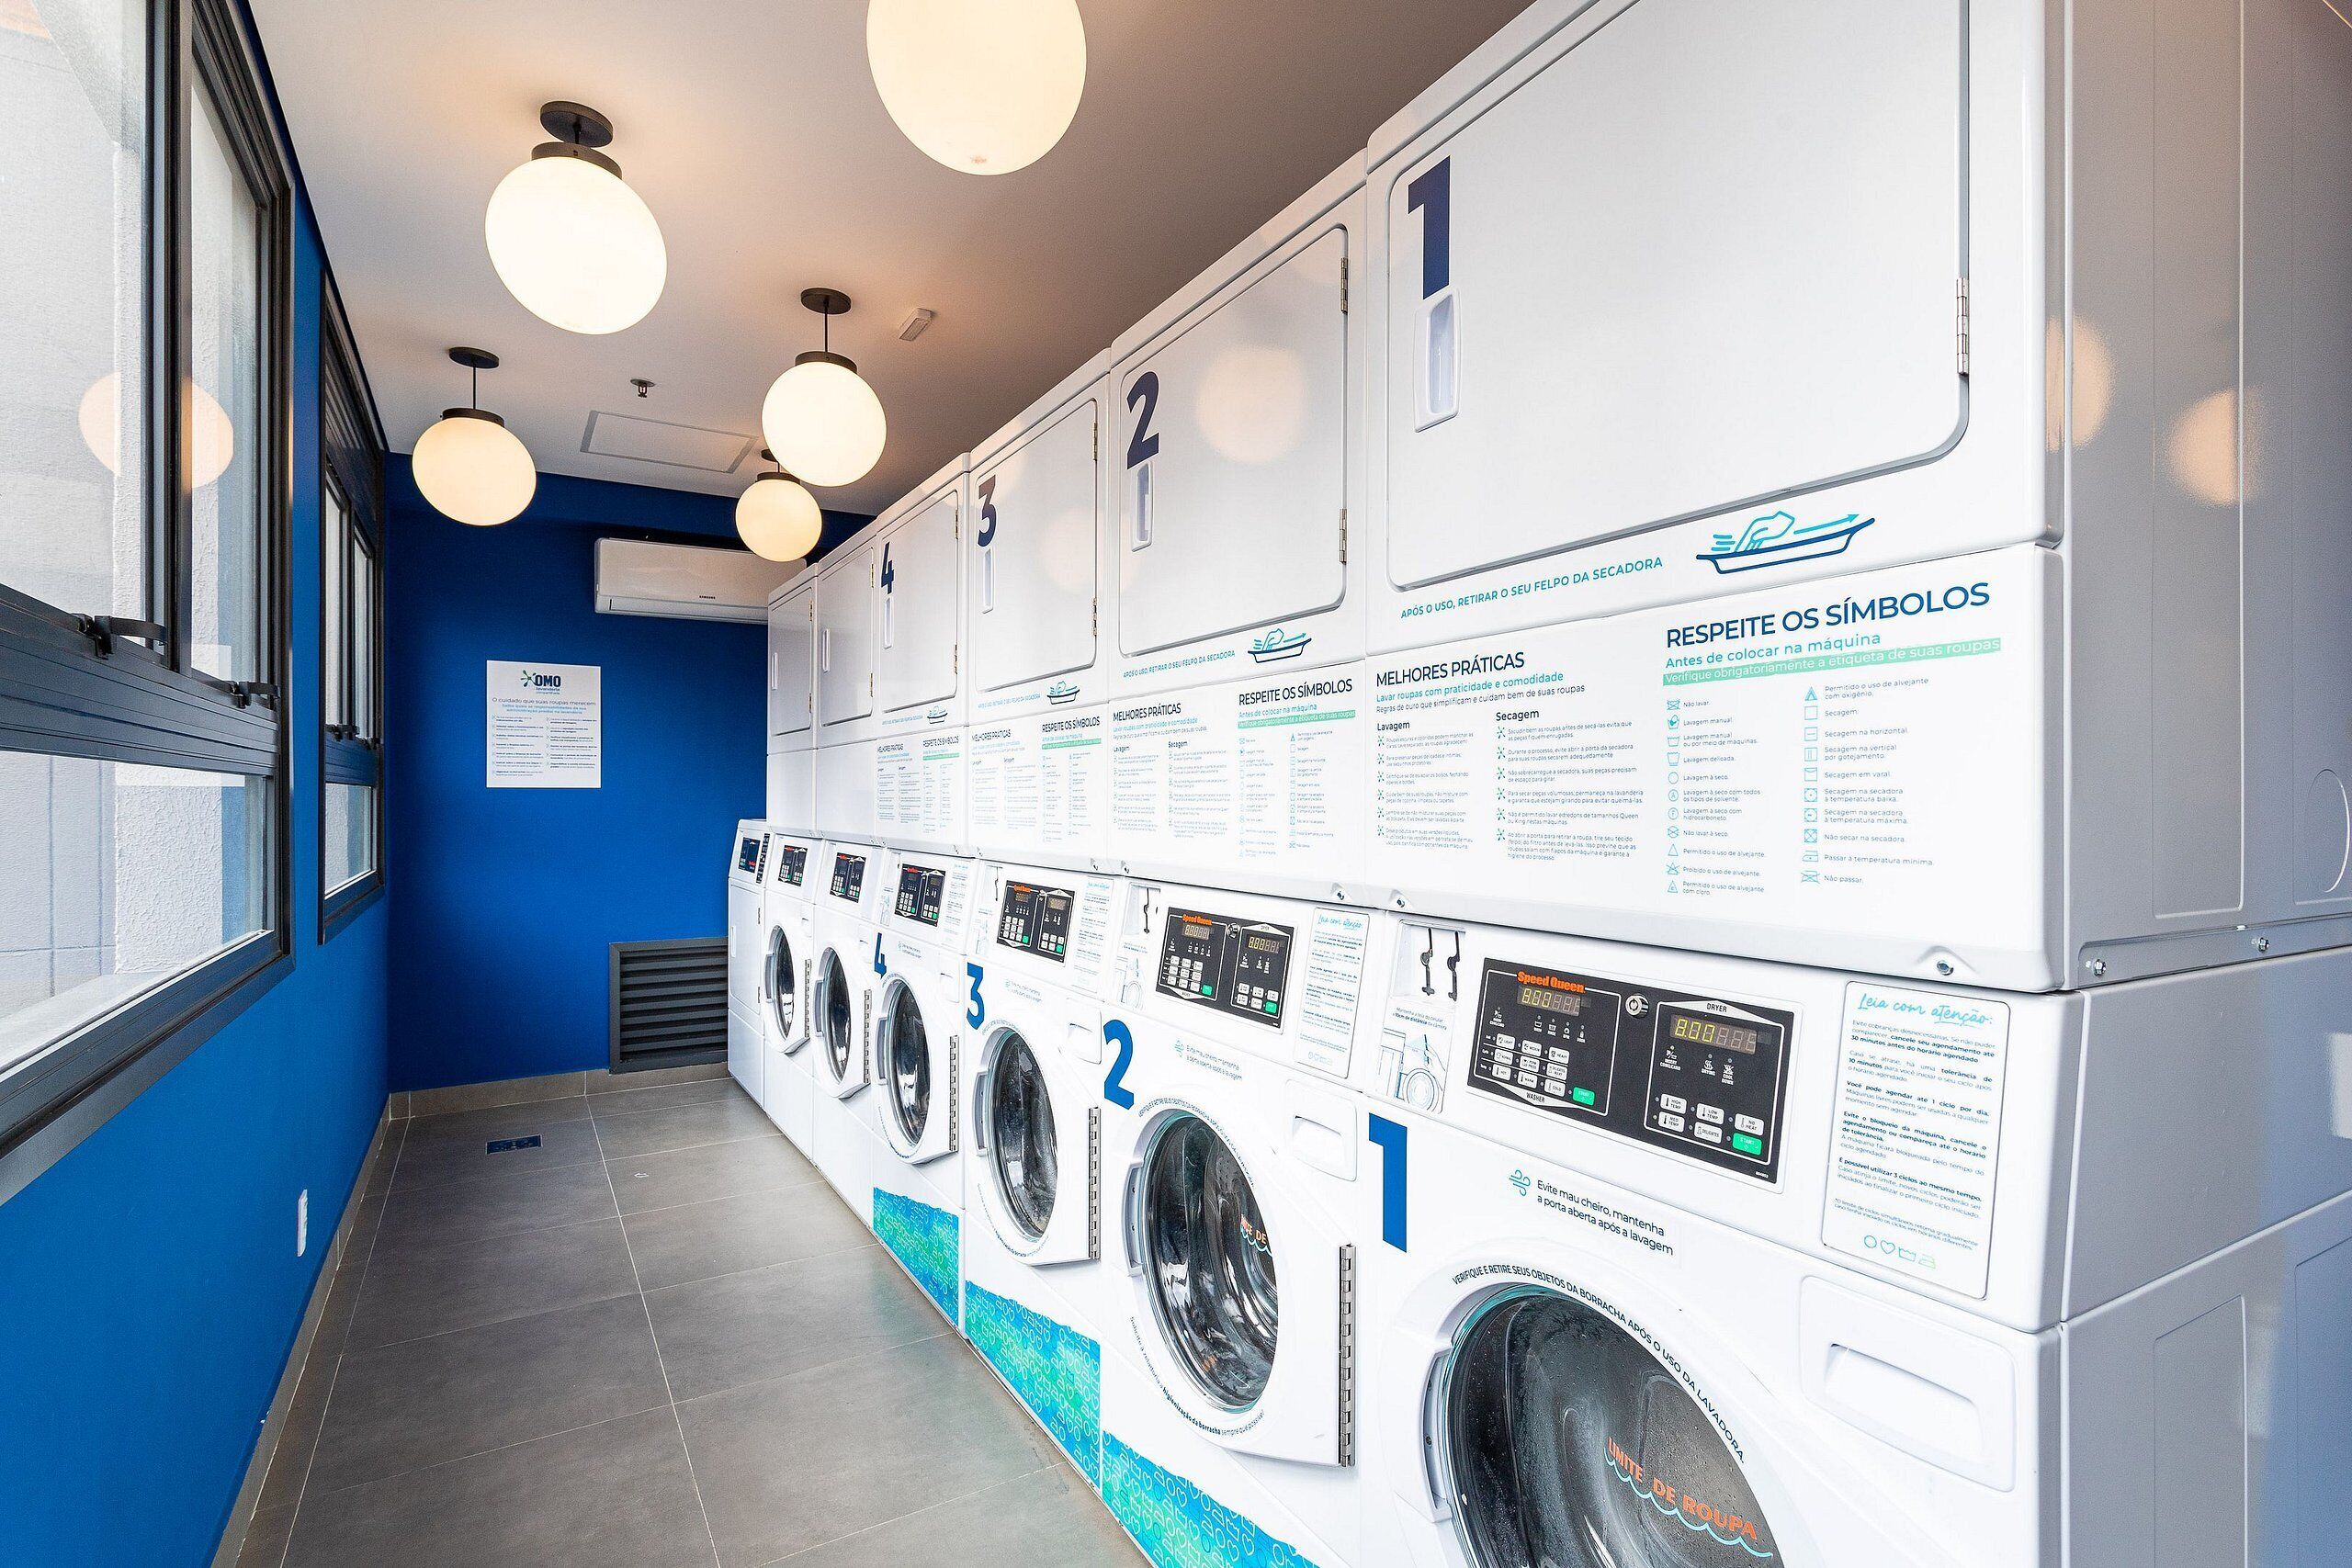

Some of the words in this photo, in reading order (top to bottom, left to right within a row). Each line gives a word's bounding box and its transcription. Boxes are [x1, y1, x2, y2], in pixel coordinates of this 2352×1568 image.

[1408, 155, 1450, 299] 1
[1127, 371, 1159, 469] 2
[978, 475, 997, 547] 3
[881, 541, 894, 594] 4
[1401, 605, 1423, 618] APÓS
[1426, 604, 1432, 613] O
[1435, 600, 1455, 611] USO,
[1458, 591, 1498, 606] RETIRAR
[1501, 589, 1508, 598] O
[1511, 583, 1531, 596] SEU
[1534, 576, 1569, 592] FELPO
[1574, 572, 1589, 583] DA
[1593, 558, 1662, 580] SECADORA
[1668, 615, 1775, 648] RESPEITE
[1782, 608, 1819, 631] OS
[1826, 582, 1989, 626] SÍMBOLOS
[1666, 658, 1702, 668] Antes
[1707, 652, 1723, 663] de
[1728, 647, 1779, 660] colocar
[1785, 644, 1802, 654] na
[1808, 634, 1880, 650] máquina
[1666, 672, 1711, 683] Verifique
[1714, 660, 1814, 678] obrigatoriamente
[1829, 652, 1883, 666] etiqueta
[1888, 649, 1905, 660] de
[1910, 646, 1942, 658] suas
[1947, 639, 1999, 654] roupas
[535, 675, 561, 687] OMO
[1377, 663, 1448, 687] MELHORES
[1452, 652, 1524, 677] PRÁTICAS
[1239, 689, 1280, 705] RESPEITE
[1283, 687, 1295, 700] OS
[1298, 679, 1352, 698] SÍMBOLOS
[1377, 692, 1395, 702] Lavar
[1397, 691, 1422, 701] roupas
[1444, 681, 1492, 696] praticidade
[1503, 672, 1563, 687] comodidade
[1557, 685, 1585, 694] roupas
[1114, 708, 1147, 721] MELHORES
[1148, 703, 1181, 716] PRÁTICAS
[1262, 709, 1282, 717] colocar
[1292, 704, 1317, 713] máquina
[1377, 722, 1409, 731] Lavagem
[1496, 711, 1539, 721] Secagem
[875, 932, 887, 979] 4
[967, 962, 984, 1030] 3
[1518, 971, 1549, 987] Speed
[1706, 1003, 1727, 1012] DRYER
[1858, 994, 1888, 1011] Leia
[1893, 1002, 1926, 1015] com
[1103, 1019, 1135, 1111] 2
[1943, 1052, 1978, 1063] agendado
[1526, 1092, 1544, 1102] WASHER
[1885, 1090, 1912, 1099] agendar
[1369, 1112, 1408, 1253] 1
[1871, 1168, 1893, 1176] utilizar
[1899, 1175, 1917, 1183] ciclos
[1929, 1183, 1955, 1193] mesmo
[1538, 1180, 1557, 1195] Evite
[1560, 1190, 1579, 1203] mau
[1581, 1198, 1611, 1217] cheiro,
[1613, 1211, 1664, 1236] mantenha
[1544, 1199, 1566, 1213] porta
[1568, 1208, 1596, 1224] aberta
[1599, 1220, 1621, 1234] após
[1631, 1229, 1673, 1255] lavagem
[1453, 1266, 1484, 1285] VERIFIQUE
[1484, 1265, 1488, 1274] E
[1488, 1265, 1512, 1274] RETIRE
[1512, 1266, 1531, 1277] SEUS
[1531, 1270, 1566, 1289] OBJETOS
[1566, 1282, 1578, 1294] DA
[1580, 1289, 1626, 1325] BORRACHA
[1628, 1320, 1652, 1343] APÓS
[1654, 1341, 1661, 1351] O
[1663, 1348, 1681, 1372] USO
[1682, 1371, 1695, 1391] DA
[1697, 1390, 1745, 1463] LAVADORA.
[1608, 1437, 1643, 1483] LIMITE
[1654, 1477, 1676, 1505] DE
[1682, 1495, 1757, 1540] ROUPA
